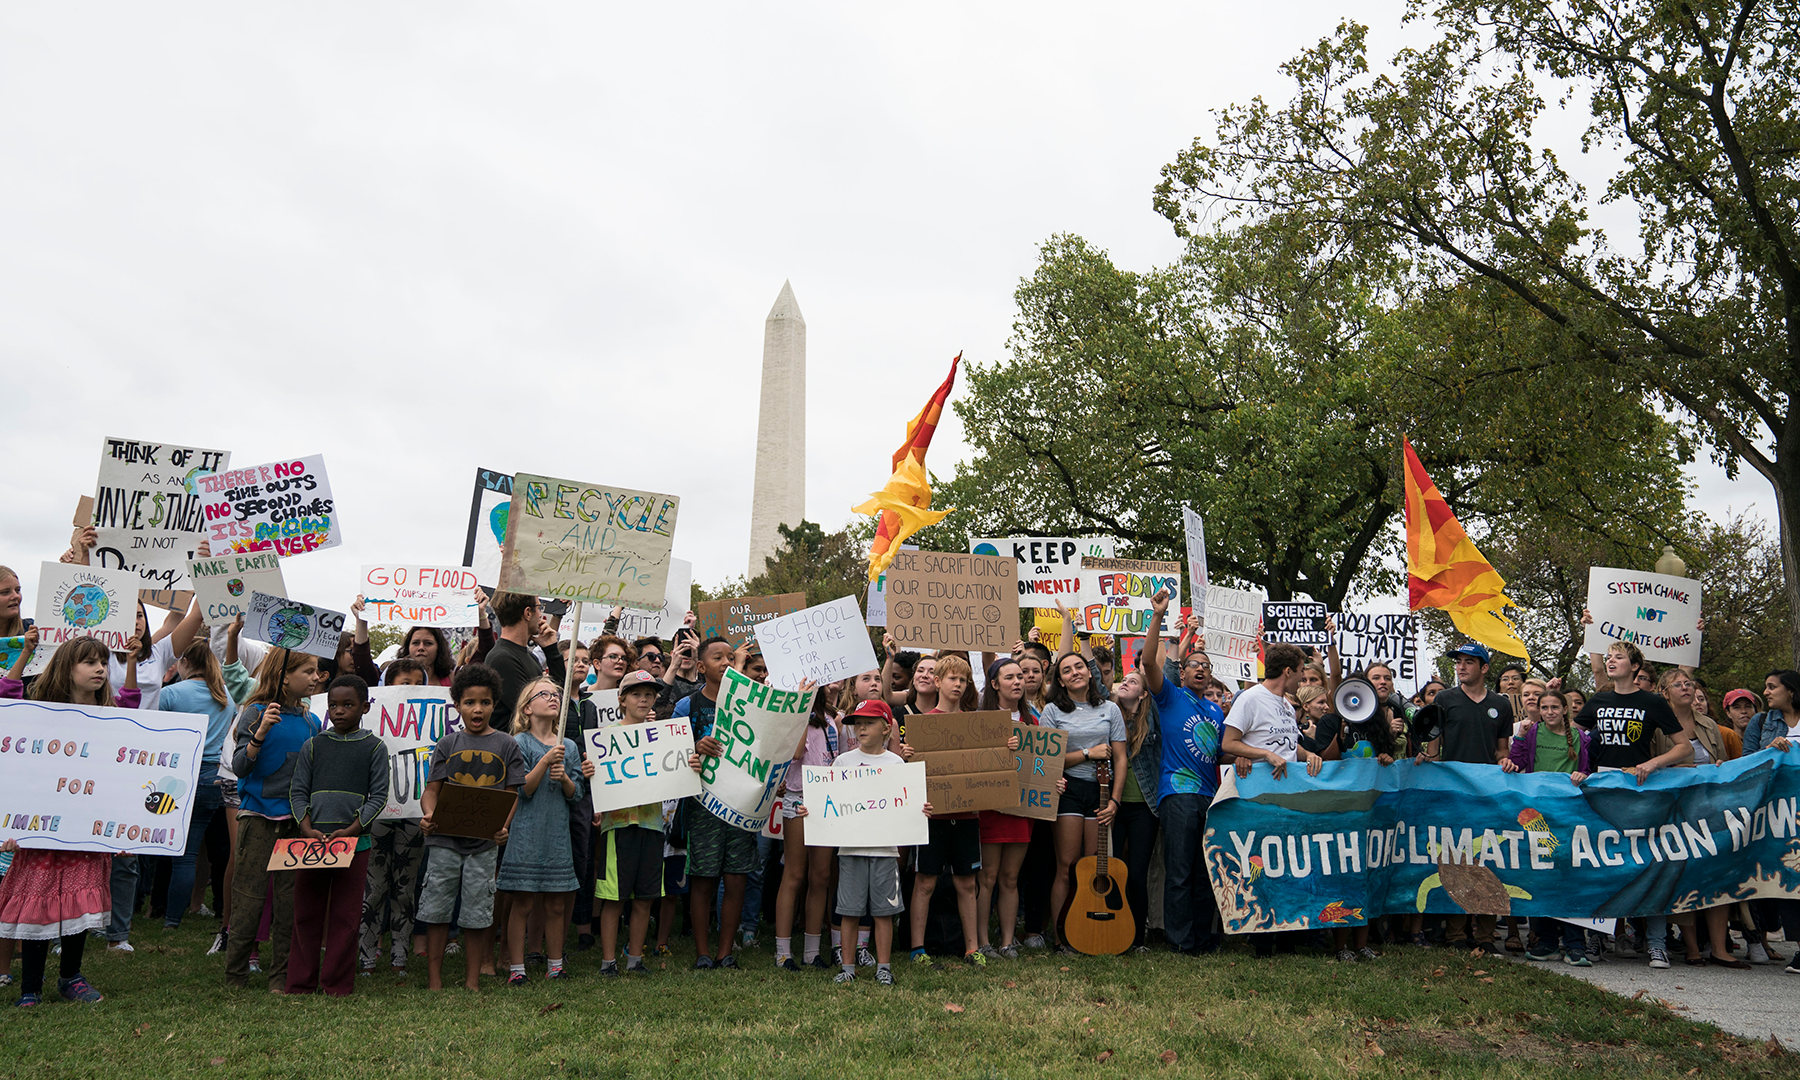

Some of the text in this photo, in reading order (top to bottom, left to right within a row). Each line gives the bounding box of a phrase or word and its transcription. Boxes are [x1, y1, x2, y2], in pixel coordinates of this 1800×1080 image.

[107, 440, 223, 472] THINK OF IT
[141, 472, 185, 486] AS AN
[199, 461, 305, 493] THERE R NO
[478, 470, 514, 496] SA
[94, 486, 207, 533] INVE$TMEN
[205, 493, 302, 521] NO SECOND
[525, 481, 676, 537] RECYCLE
[255, 514, 333, 541] NOW
[560, 523, 617, 552] AND
[130, 536, 178, 549] IN NOT
[1013, 542, 1077, 565] KEEP
[193, 553, 279, 578] MAKE EARTH
[534, 546, 651, 587] SAVE The
[924, 555, 1010, 578] SACRIFICING
[1035, 565, 1053, 575] an
[1084, 558, 1178, 573] #FRIDAYSFORFUTURE
[73, 572, 108, 588] CHANGE
[367, 567, 478, 590] GO FLOOD
[893, 579, 919, 596] OUR
[928, 581, 1002, 601] EDUCATION
[1099, 573, 1178, 600] FRIDAYS
[52, 581, 72, 617] CLIMATE
[106, 588, 117, 598] IS
[254, 593, 275, 603] STOP
[393, 588, 440, 600] YOURSELF
[1107, 596, 1130, 607] FOR
[1607, 581, 1690, 605] SYSTEM CHANGE
[107, 600, 120, 617] REAL
[371, 601, 447, 622] TRUMP
[730, 603, 752, 615] OUR
[743, 612, 779, 622] FUTURE
[918, 602, 978, 621] TO SAVE
[1267, 605, 1325, 618] SCIENCE
[1636, 605, 1668, 623] NOT
[318, 612, 345, 633] GO
[611, 612, 662, 635] ROFIT?
[761, 604, 855, 644] SCHOOL
[1277, 618, 1313, 631] OVER
[781, 626, 846, 655] STRIKE
[893, 622, 1006, 647] OUR FUTURE!
[1265, 630, 1327, 643] TYRANTS
[1333, 631, 1418, 659] LIMATE
[1600, 621, 1691, 650] CLIMATE CHANGE
[798, 650, 821, 666] FOR
[1227, 637, 1254, 660] FIRE
[1239, 662, 1252, 678] IS
[726, 668, 814, 715] THERE
[724, 692, 747, 717] IS
[1596, 707, 1646, 722] GREEN
[379, 698, 463, 743] NATUR
[716, 708, 755, 747] NO
[1183, 714, 1202, 733] THINK
[1596, 718, 1626, 732] NEW
[0, 736, 181, 769] SCHOOL STRIKE
[591, 723, 688, 760] SAVE THE
[1013, 727, 1062, 757] DAYS
[1184, 738, 1201, 758] BIKE
[600, 752, 658, 785] ICE
[700, 754, 721, 785] B
[961, 747, 1014, 772] NOW
[56, 777, 96, 795] FOR
[806, 767, 883, 784] Don't Kill the
[823, 786, 909, 818] Amazon!
[92, 820, 176, 847] REFORM!
[1228, 796, 1797, 880] YOUTH OR CLIMATE ACTION NOW
